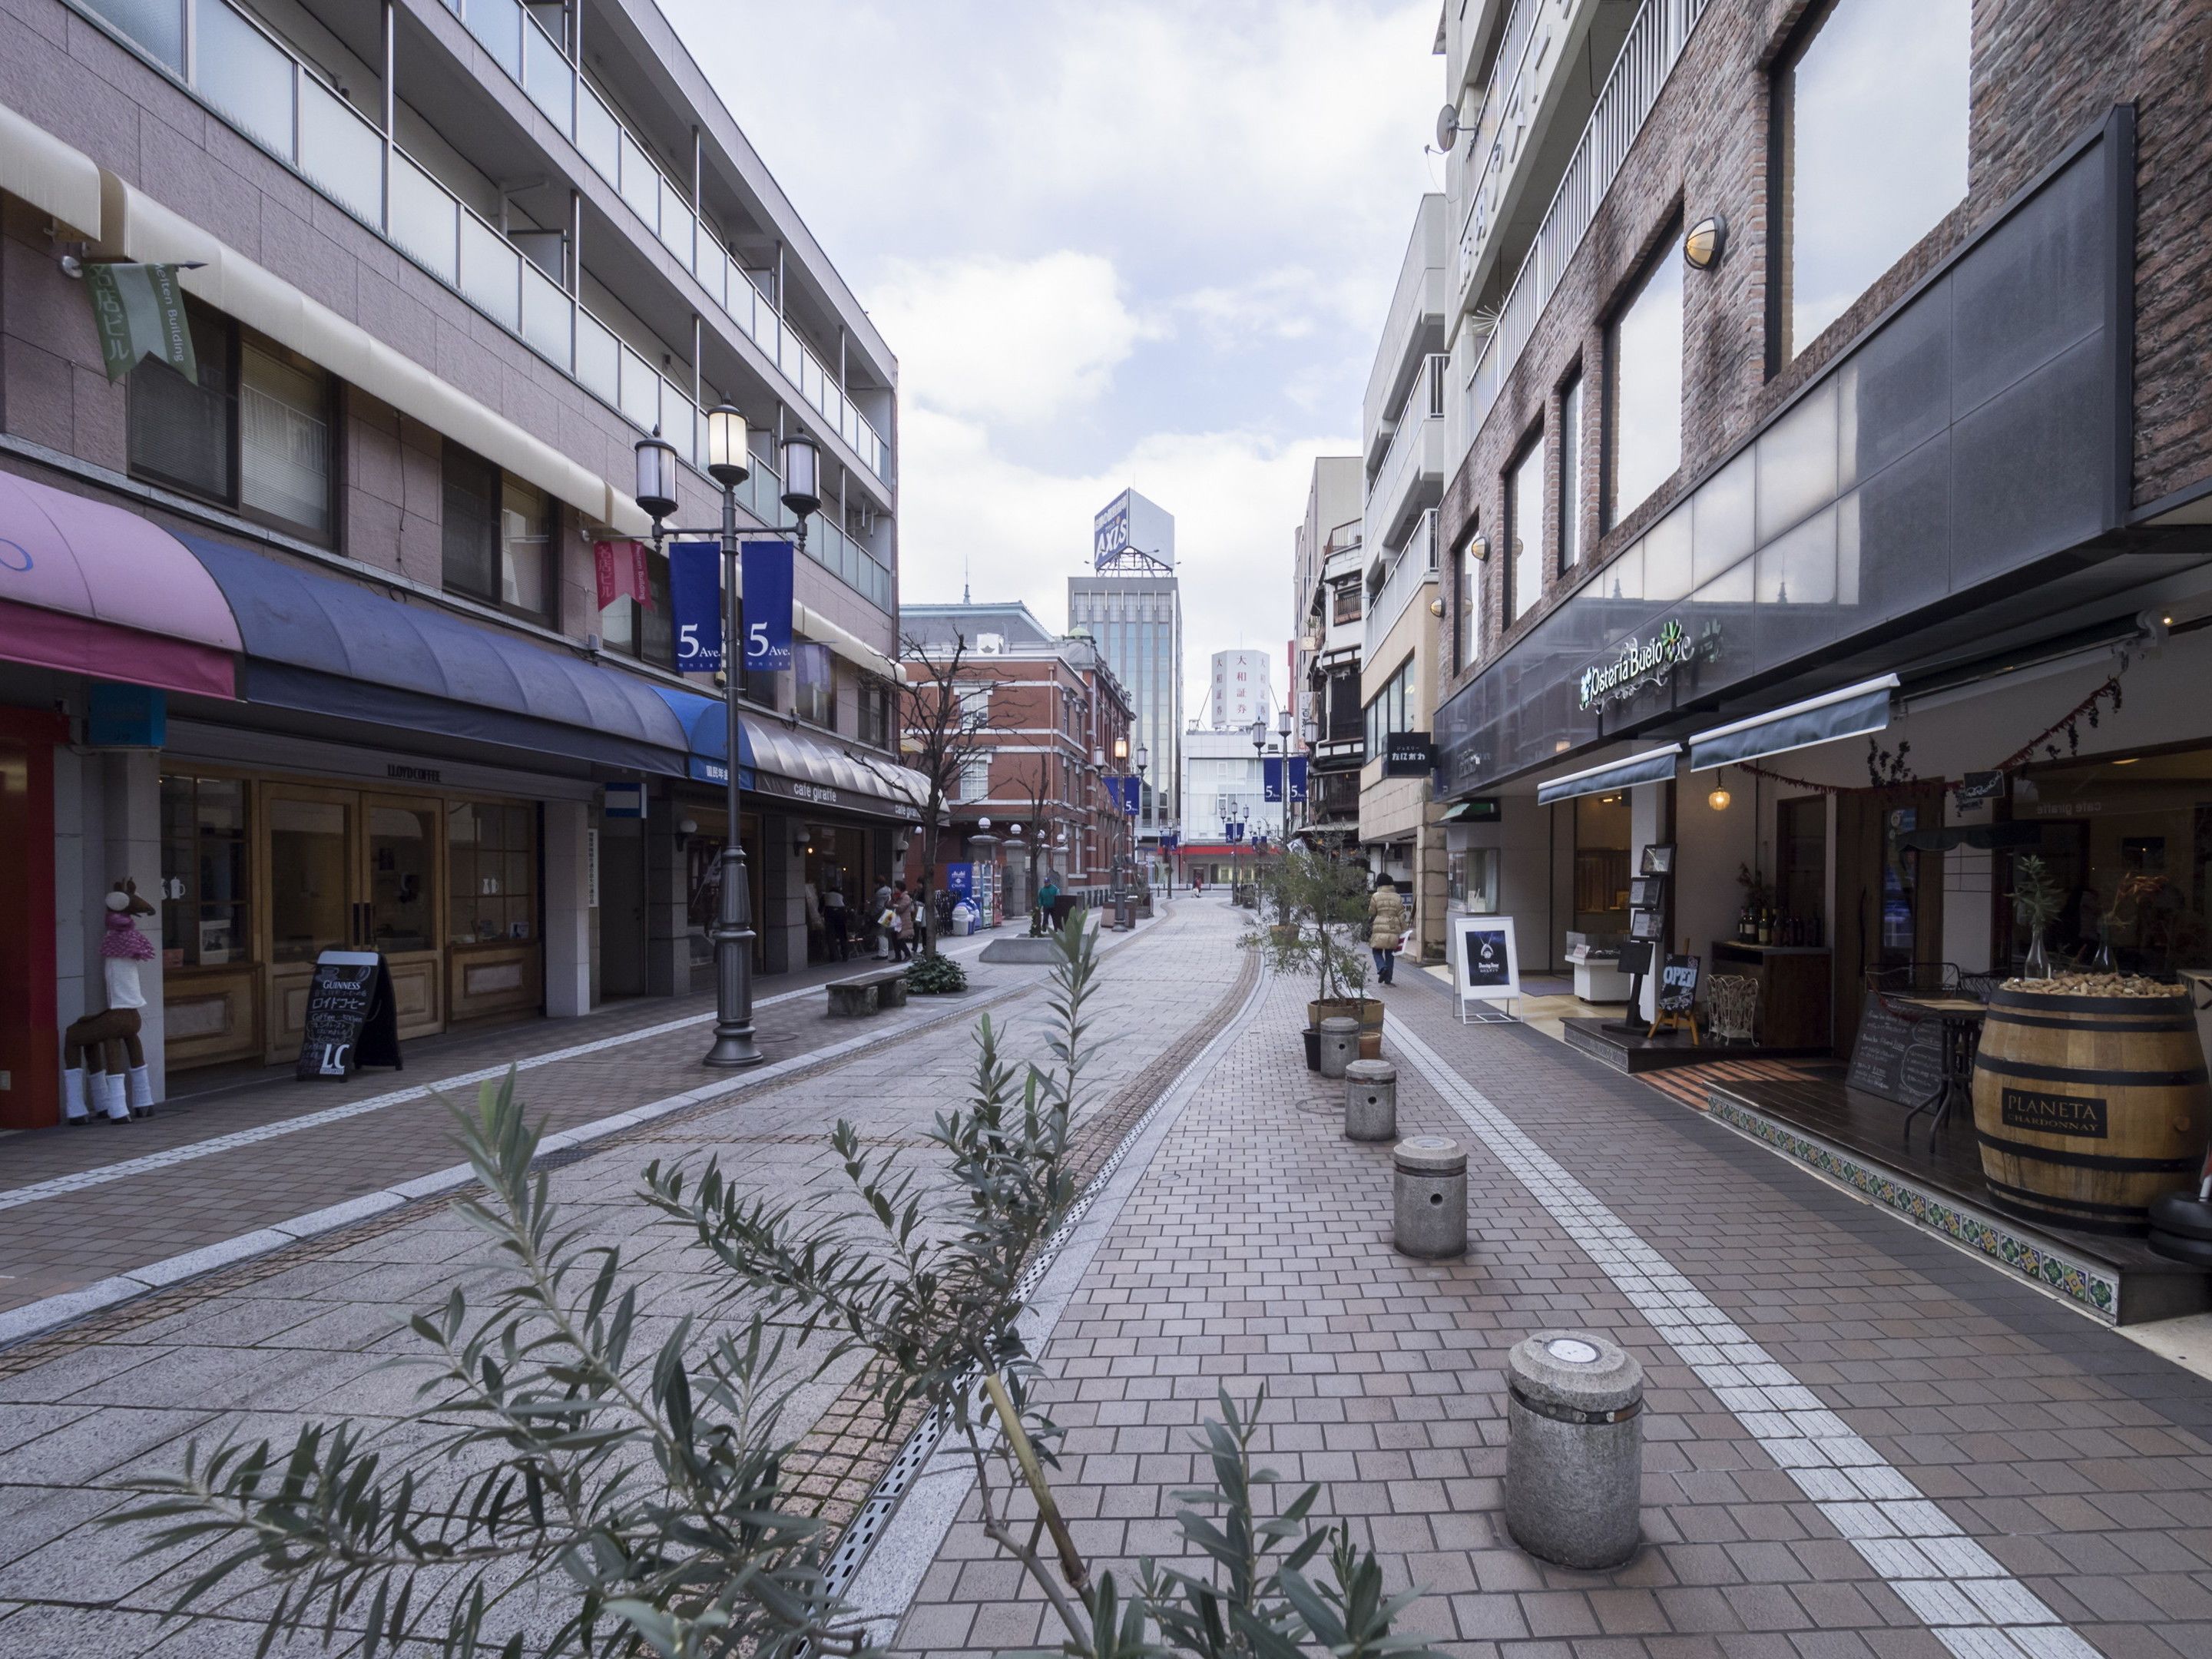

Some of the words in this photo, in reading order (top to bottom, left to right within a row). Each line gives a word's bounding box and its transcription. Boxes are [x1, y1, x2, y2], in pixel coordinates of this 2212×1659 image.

[167, 309, 184, 363] Building
[677, 623, 699, 658] 5
[699, 647, 720, 657] Ave.
[747, 621, 769, 657] 5
[769, 646, 790, 657] Ave.
[1236, 655, 1247, 714] 大和証券
[387, 763, 413, 779] LLOYD
[813, 786, 836, 802] giraffe
[1266, 785, 1273, 798] 5
[1290, 784, 1298, 798] 5
[1125, 800, 1132, 812] 5
[323, 979, 362, 991] GUINNESS
[1663, 965, 1697, 988] OPEN
[321, 1043, 351, 1069] LC
[2008, 1094, 2098, 1121] PLANETA
[2007, 1114, 2099, 1132] CHARDONNAY
